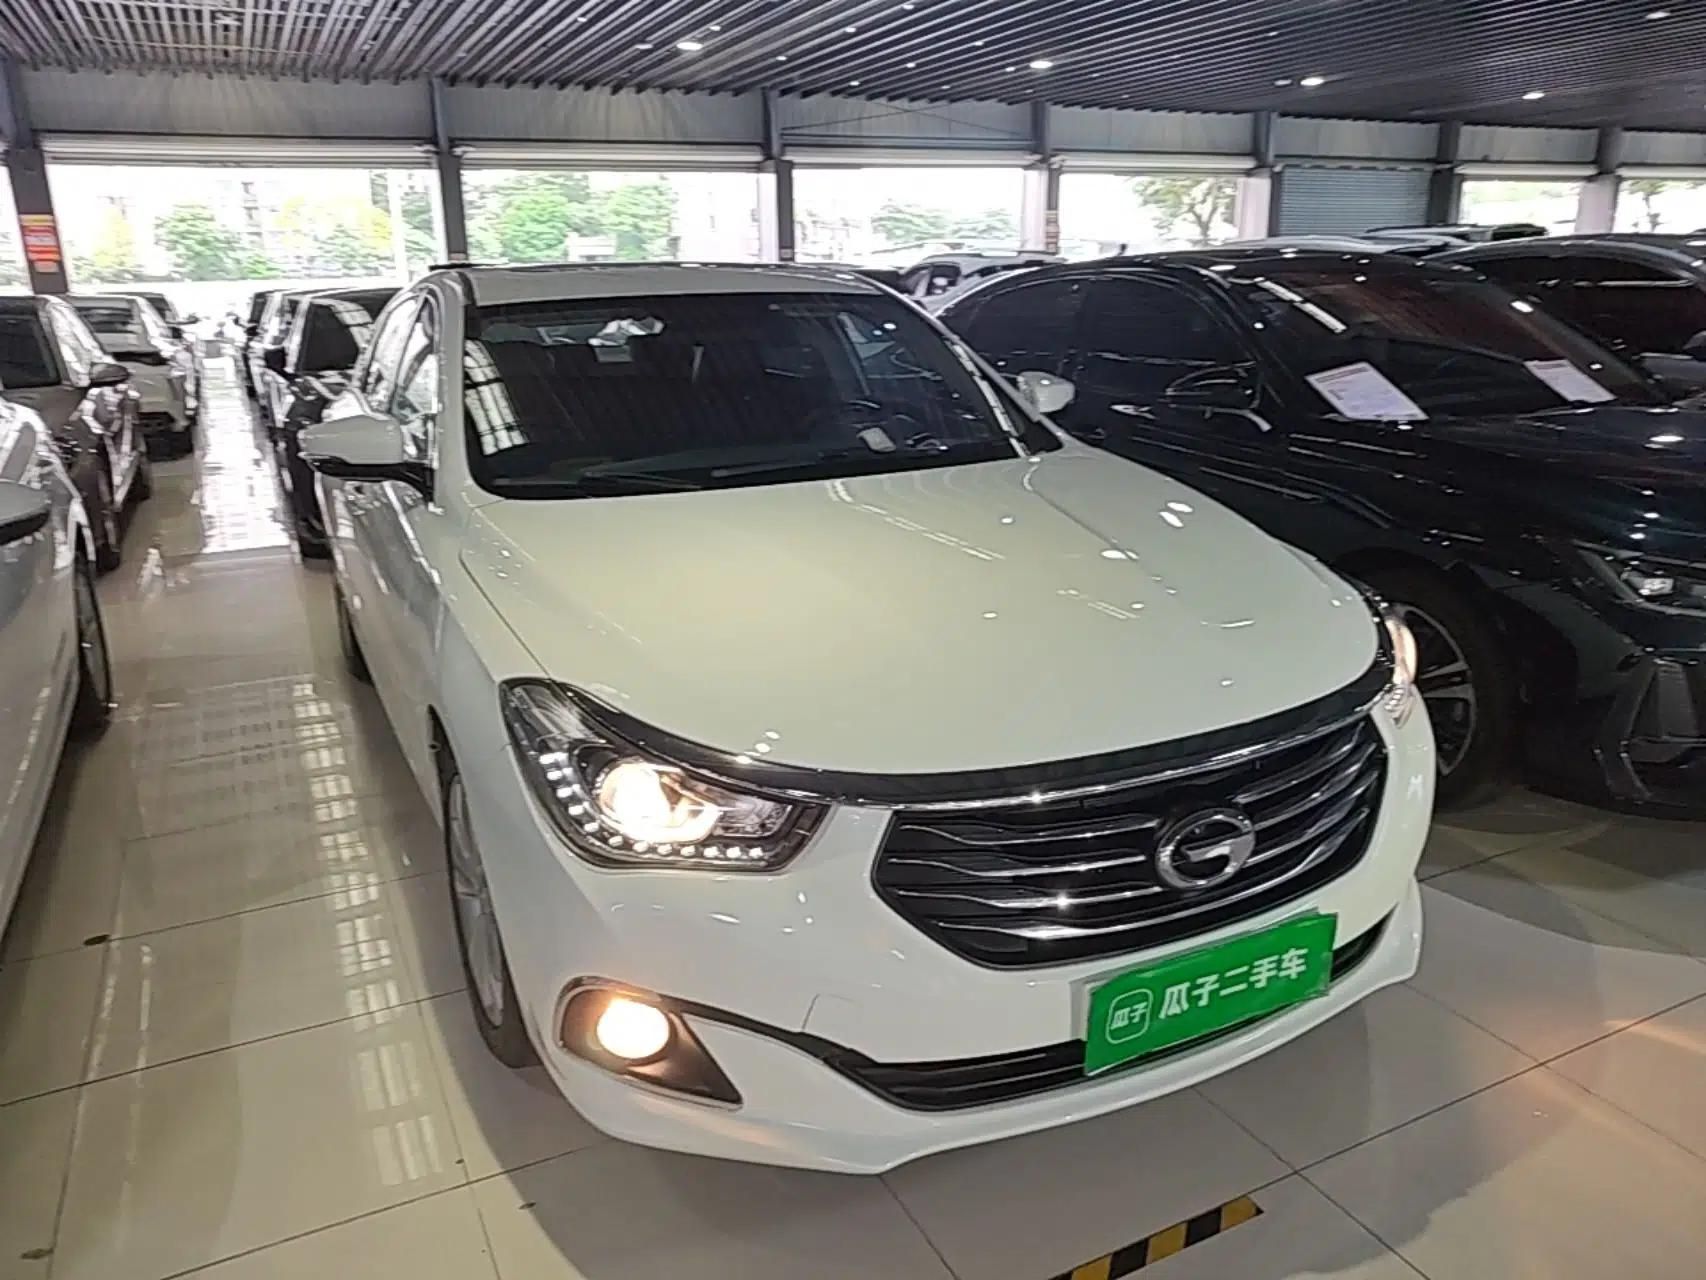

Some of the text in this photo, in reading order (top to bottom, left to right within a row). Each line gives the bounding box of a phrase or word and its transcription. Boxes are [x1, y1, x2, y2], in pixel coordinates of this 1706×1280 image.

[1158, 948, 1309, 1019] 瓜子二手车
